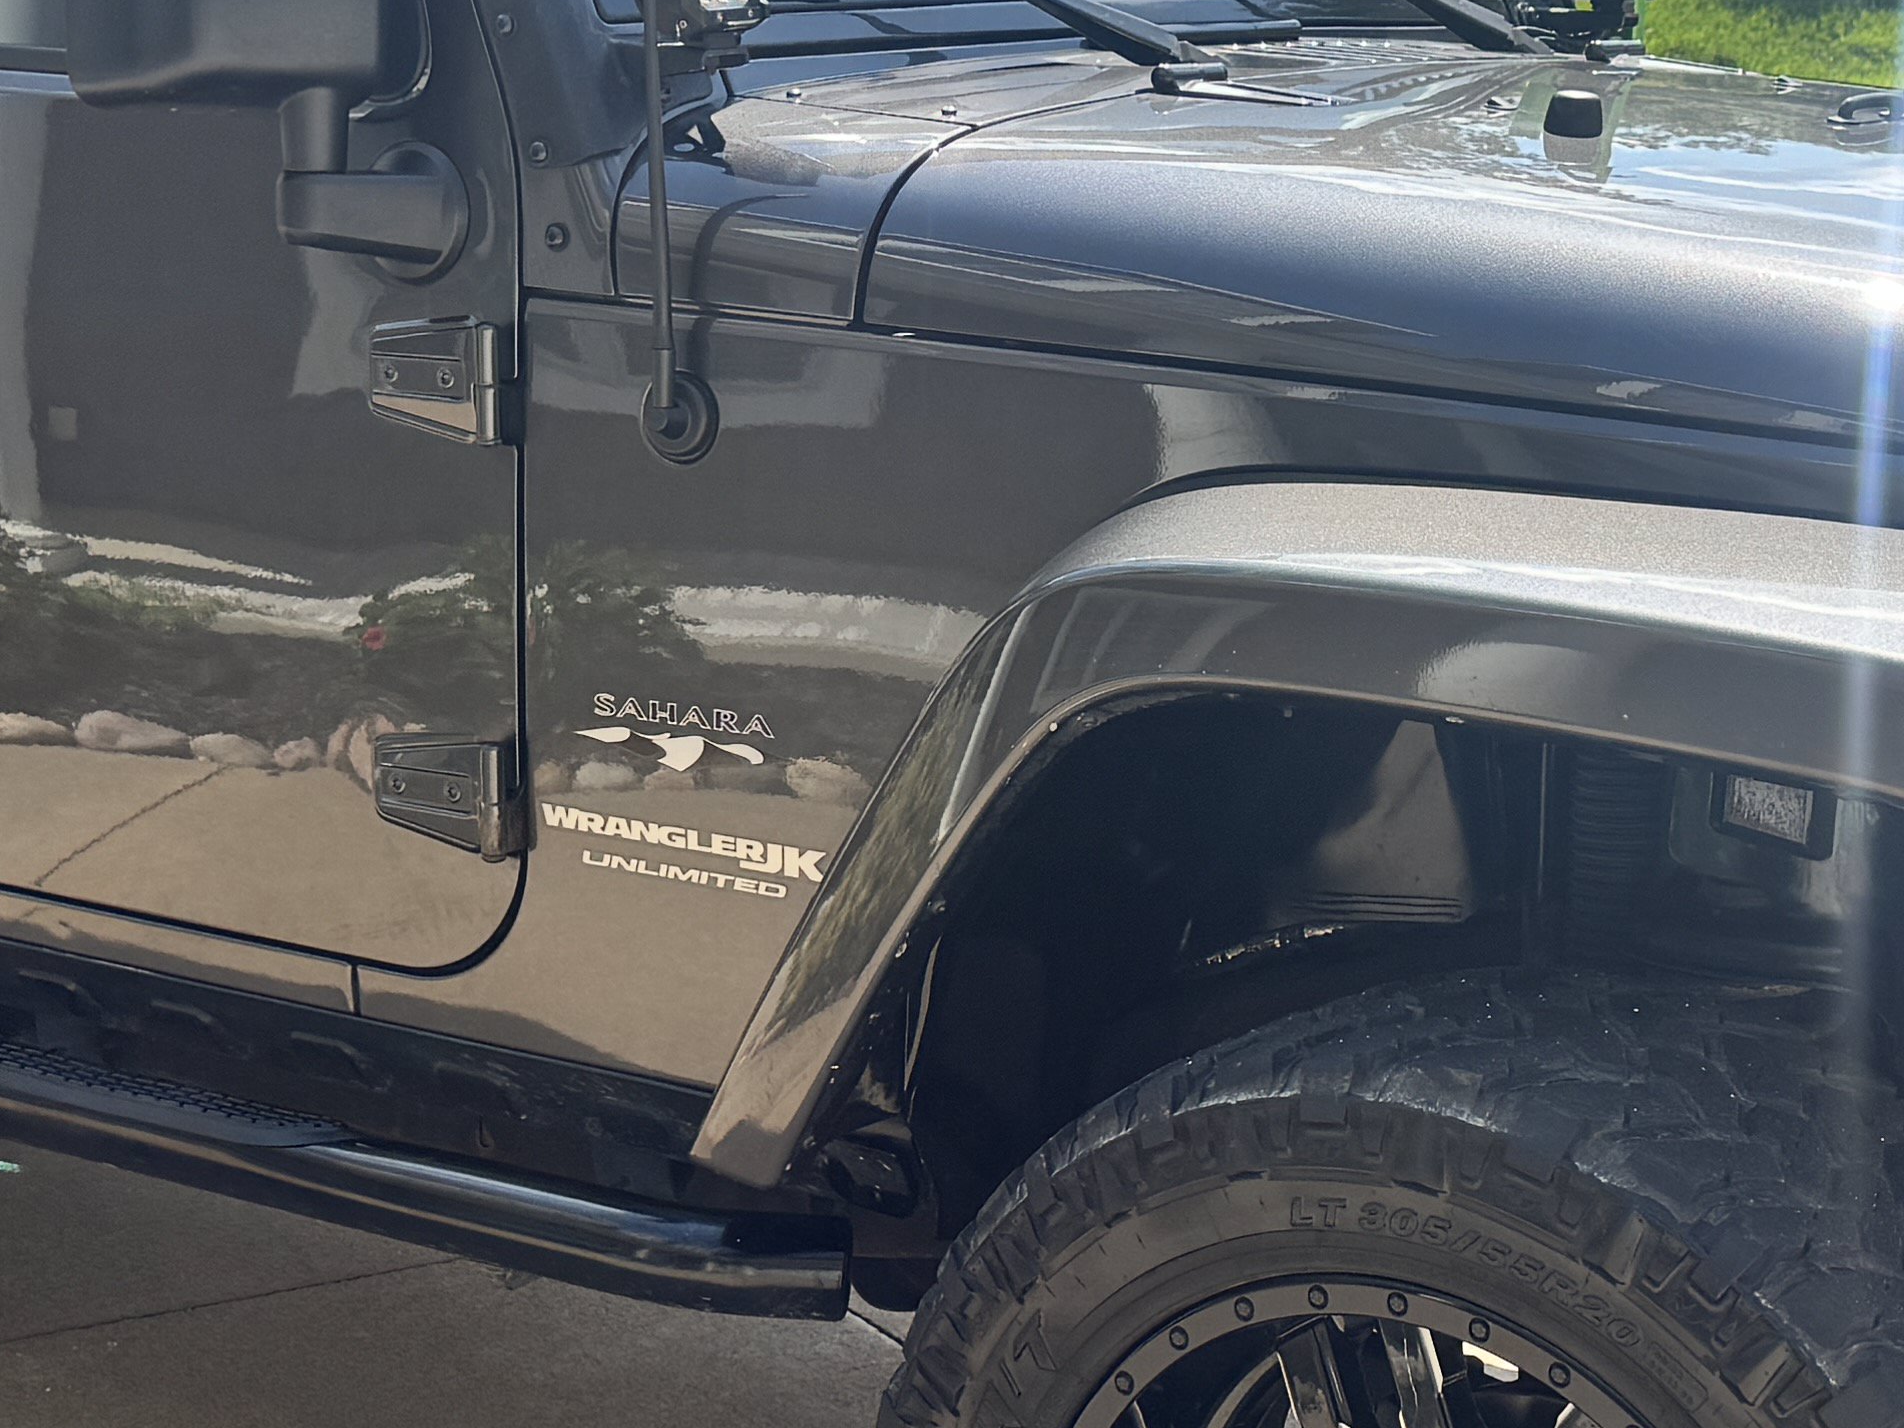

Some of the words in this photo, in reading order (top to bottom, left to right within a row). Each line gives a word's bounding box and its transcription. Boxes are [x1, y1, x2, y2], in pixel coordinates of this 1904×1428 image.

[593, 692, 776, 740] SAHARA
[581, 849, 789, 899] UNLIMITED
[1288, 1195, 1348, 1229] LT
[1358, 1199, 1644, 1353] 305/55R20
